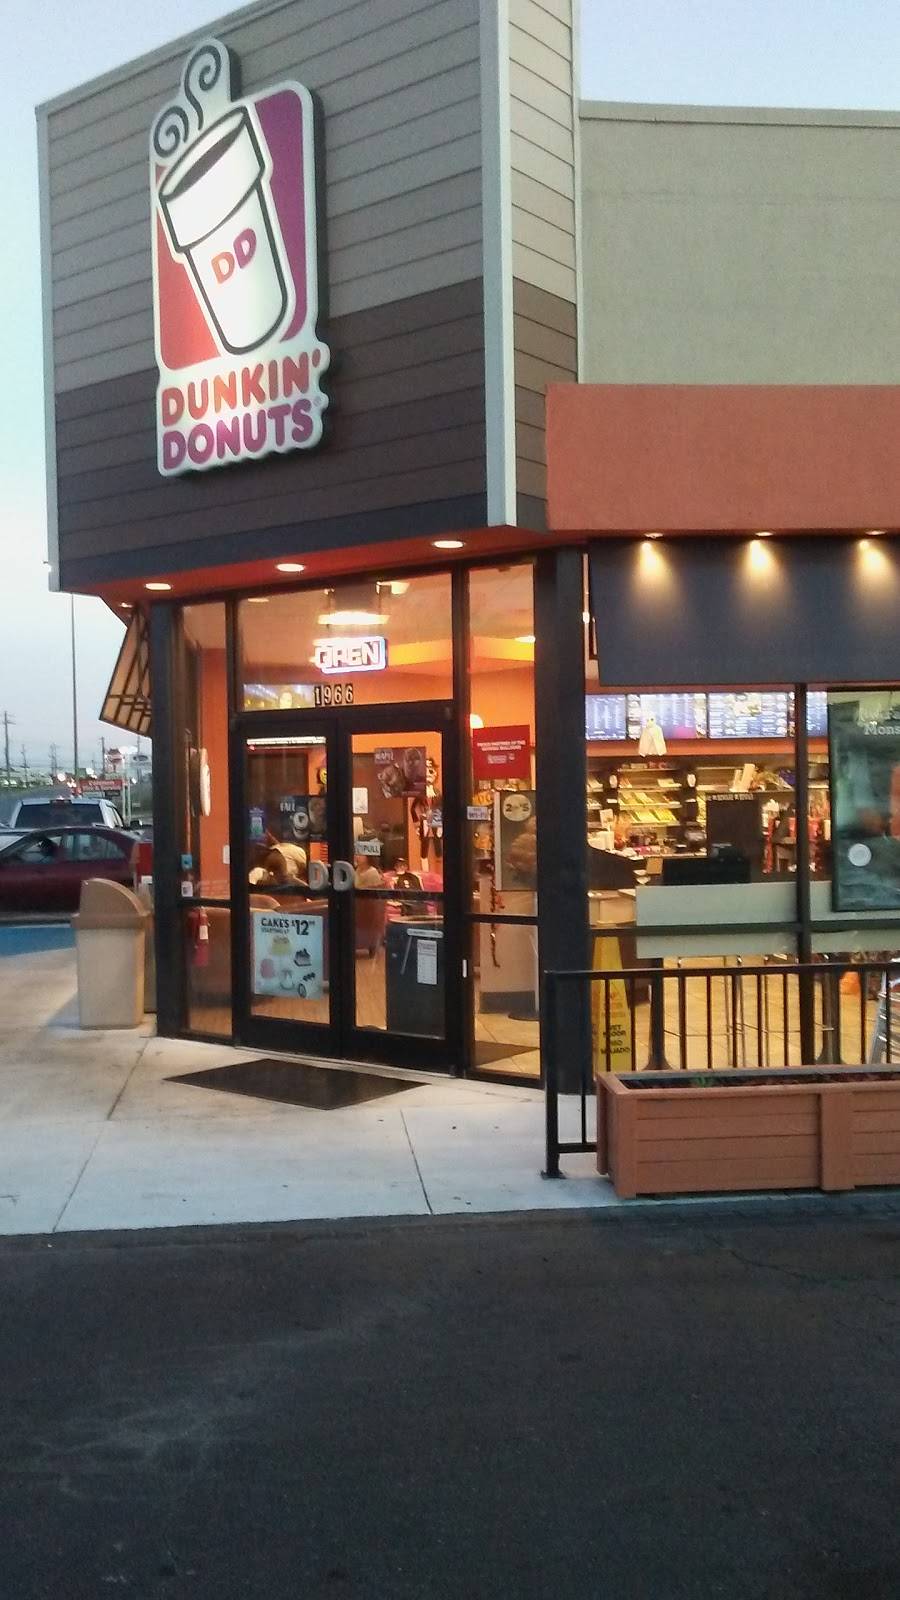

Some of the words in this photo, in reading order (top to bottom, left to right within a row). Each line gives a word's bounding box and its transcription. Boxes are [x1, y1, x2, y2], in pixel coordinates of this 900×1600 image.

[161, 348, 321, 427] DUNKIN'
[163, 399, 314, 471] DONUTS
[315, 641, 381, 668] OPEN
[314, 684, 353, 705] 1966
[261, 917, 290, 928] CAKES
